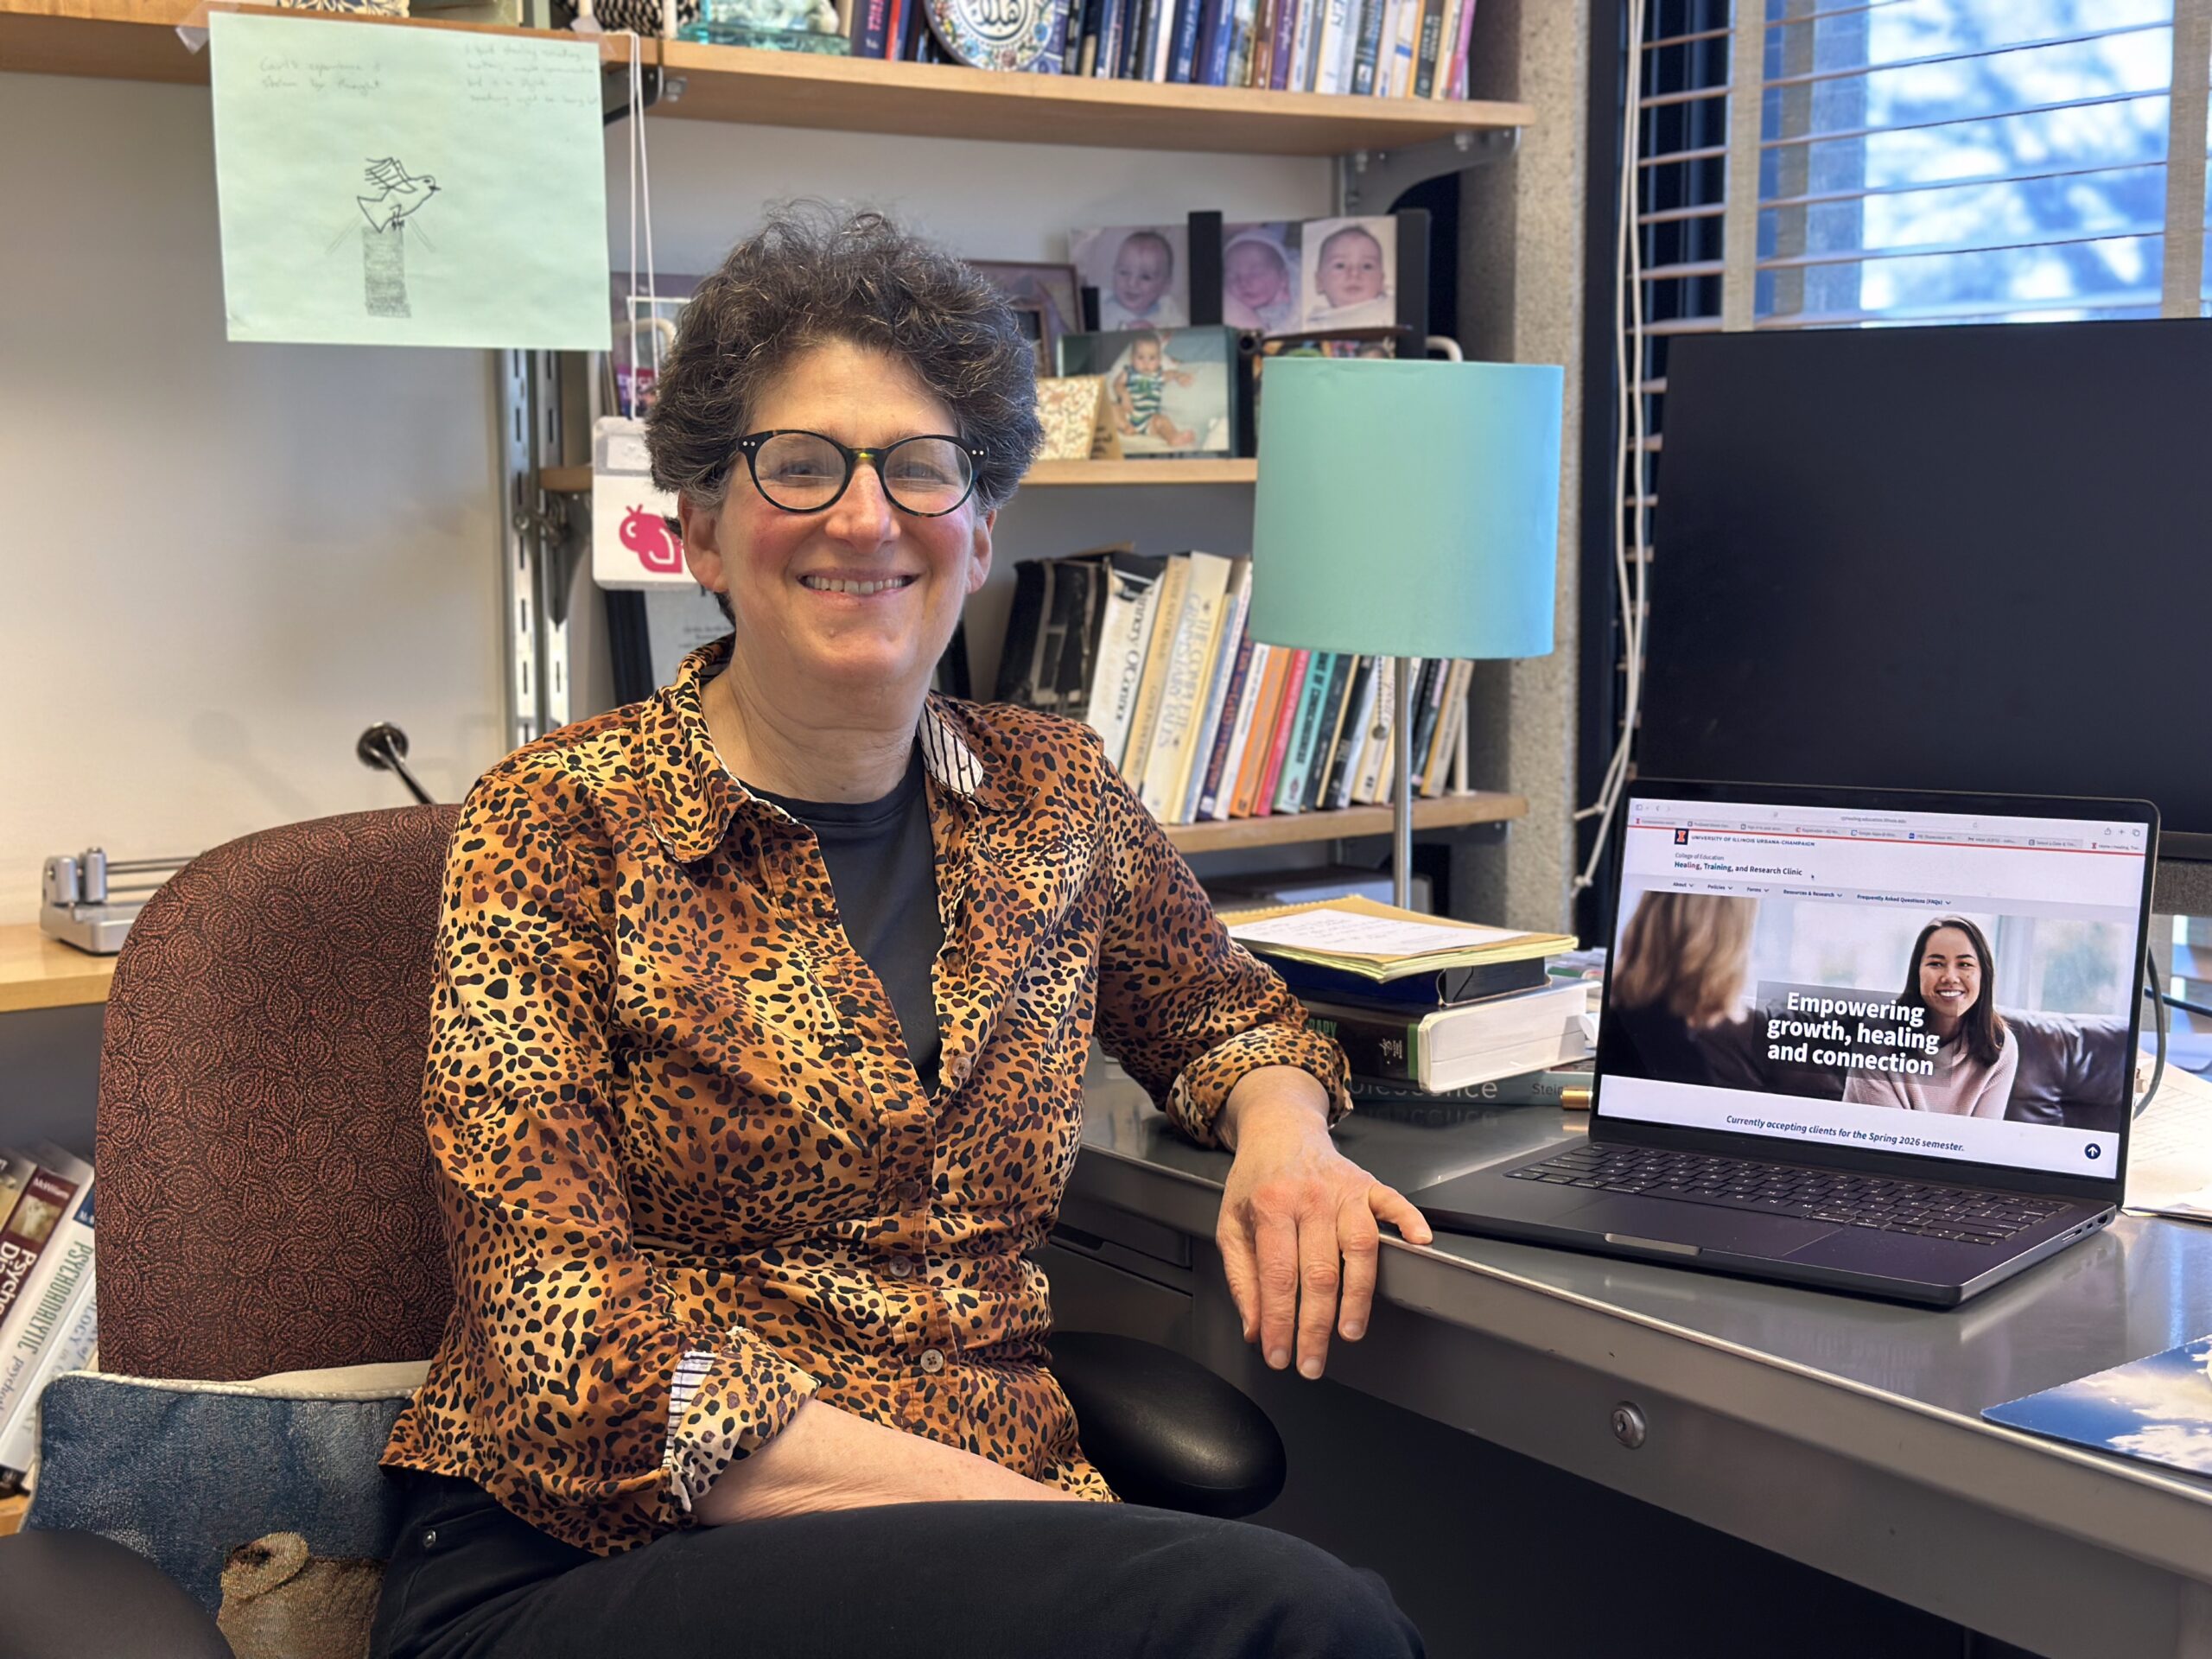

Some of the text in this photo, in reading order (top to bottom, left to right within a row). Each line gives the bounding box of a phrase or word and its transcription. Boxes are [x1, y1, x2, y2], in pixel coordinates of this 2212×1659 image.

[1675, 852, 1694, 861] College
[1675, 861, 1702, 871] Healing,
[1704, 863, 1733, 873] Training,
[1750, 866, 1781, 874] Research
[1783, 868, 1802, 876] Clinic
[1857, 893, 1884, 902] Frequently
[1787, 991, 1925, 1027] Empowering
[1767, 1019, 1940, 1055] growth, healing
[1767, 1043, 1934, 1076] and connection
[1726, 1115, 1764, 1128] Currently
[1766, 1121, 1807, 1135] accepting
[1808, 1125, 1837, 1136] clients
[1839, 1128, 1851, 1138] for
[1853, 1130, 1867, 1140] the
[1868, 1132, 1898, 1145] Spring
[1922, 1140, 1966, 1152] semester.
[0, 1249, 37, 1316] Psycho
[17, 1241, 94, 1355] PSYCHOANALYTIC
